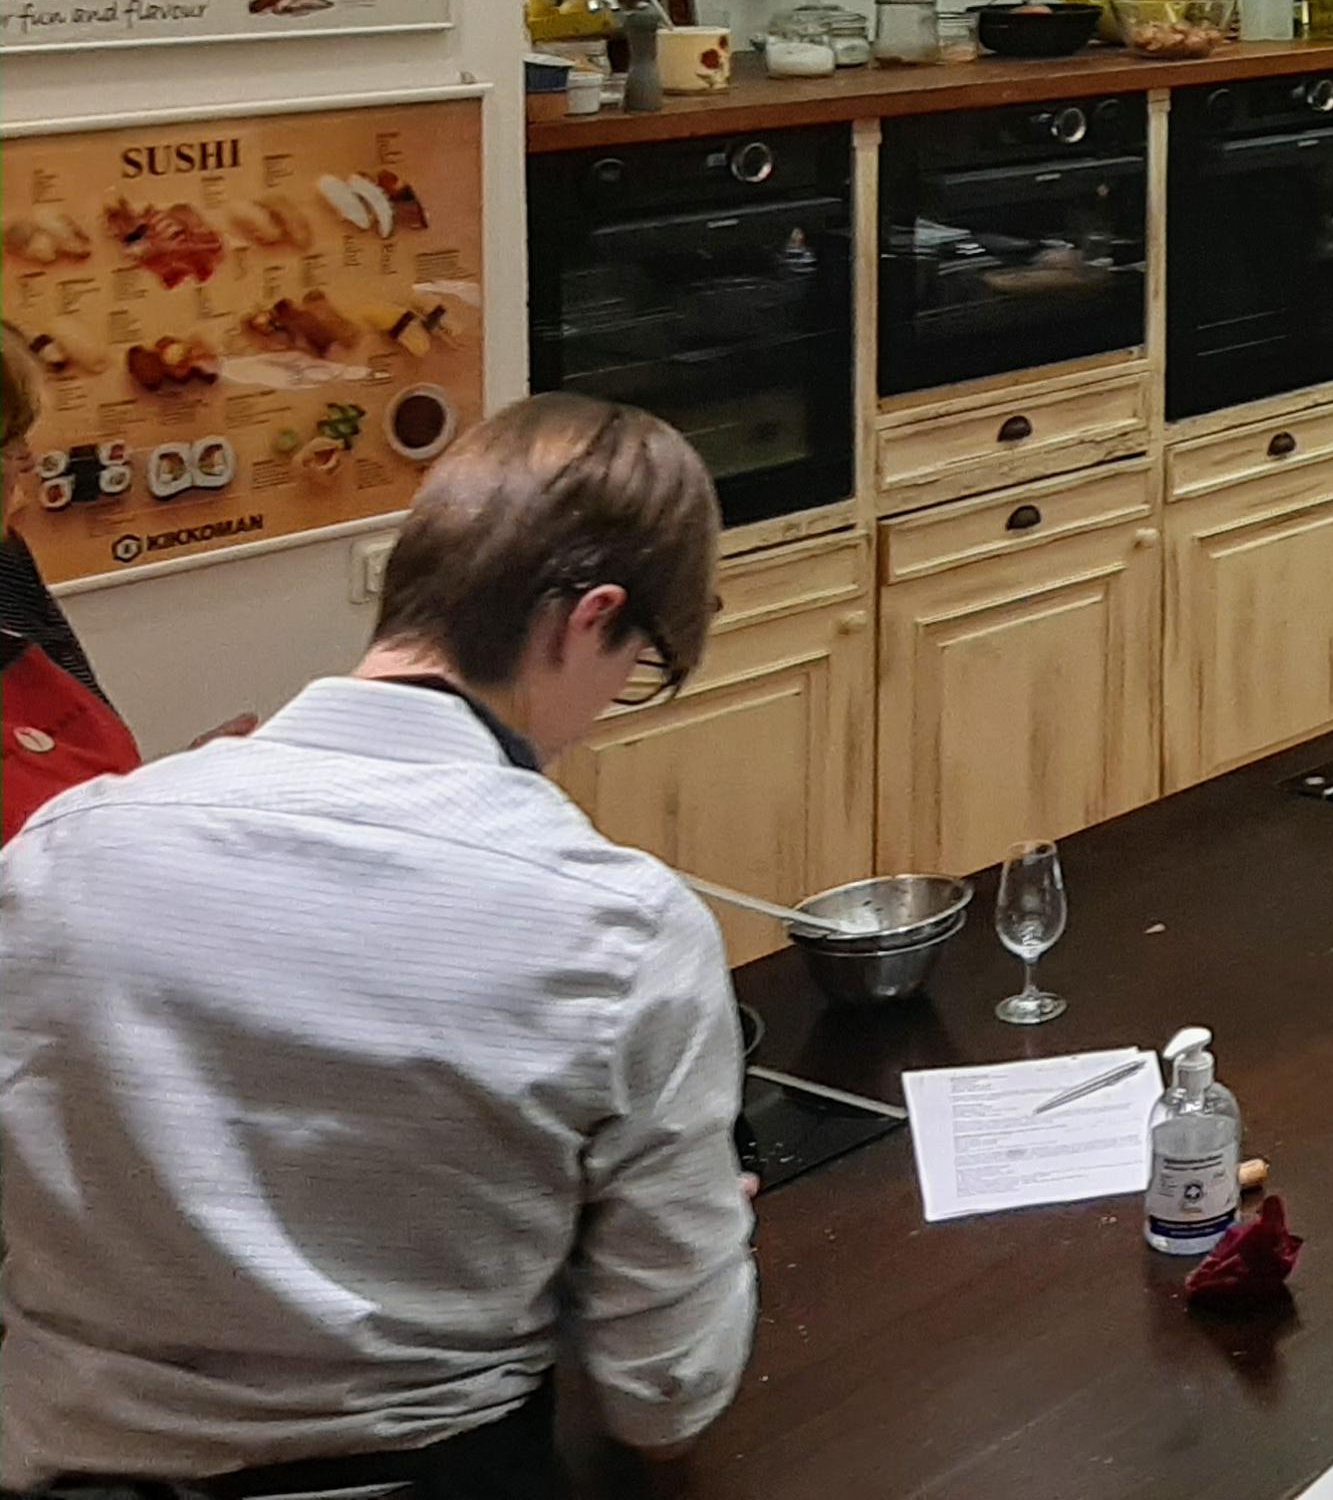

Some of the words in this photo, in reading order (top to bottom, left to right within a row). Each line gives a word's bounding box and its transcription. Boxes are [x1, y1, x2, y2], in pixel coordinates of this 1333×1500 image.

[18, 3, 67, 34] fun
[72, 3, 119, 24] and
[121, 139, 241, 179] SUSHI
[147, 514, 264, 551] KIKKOMAN
